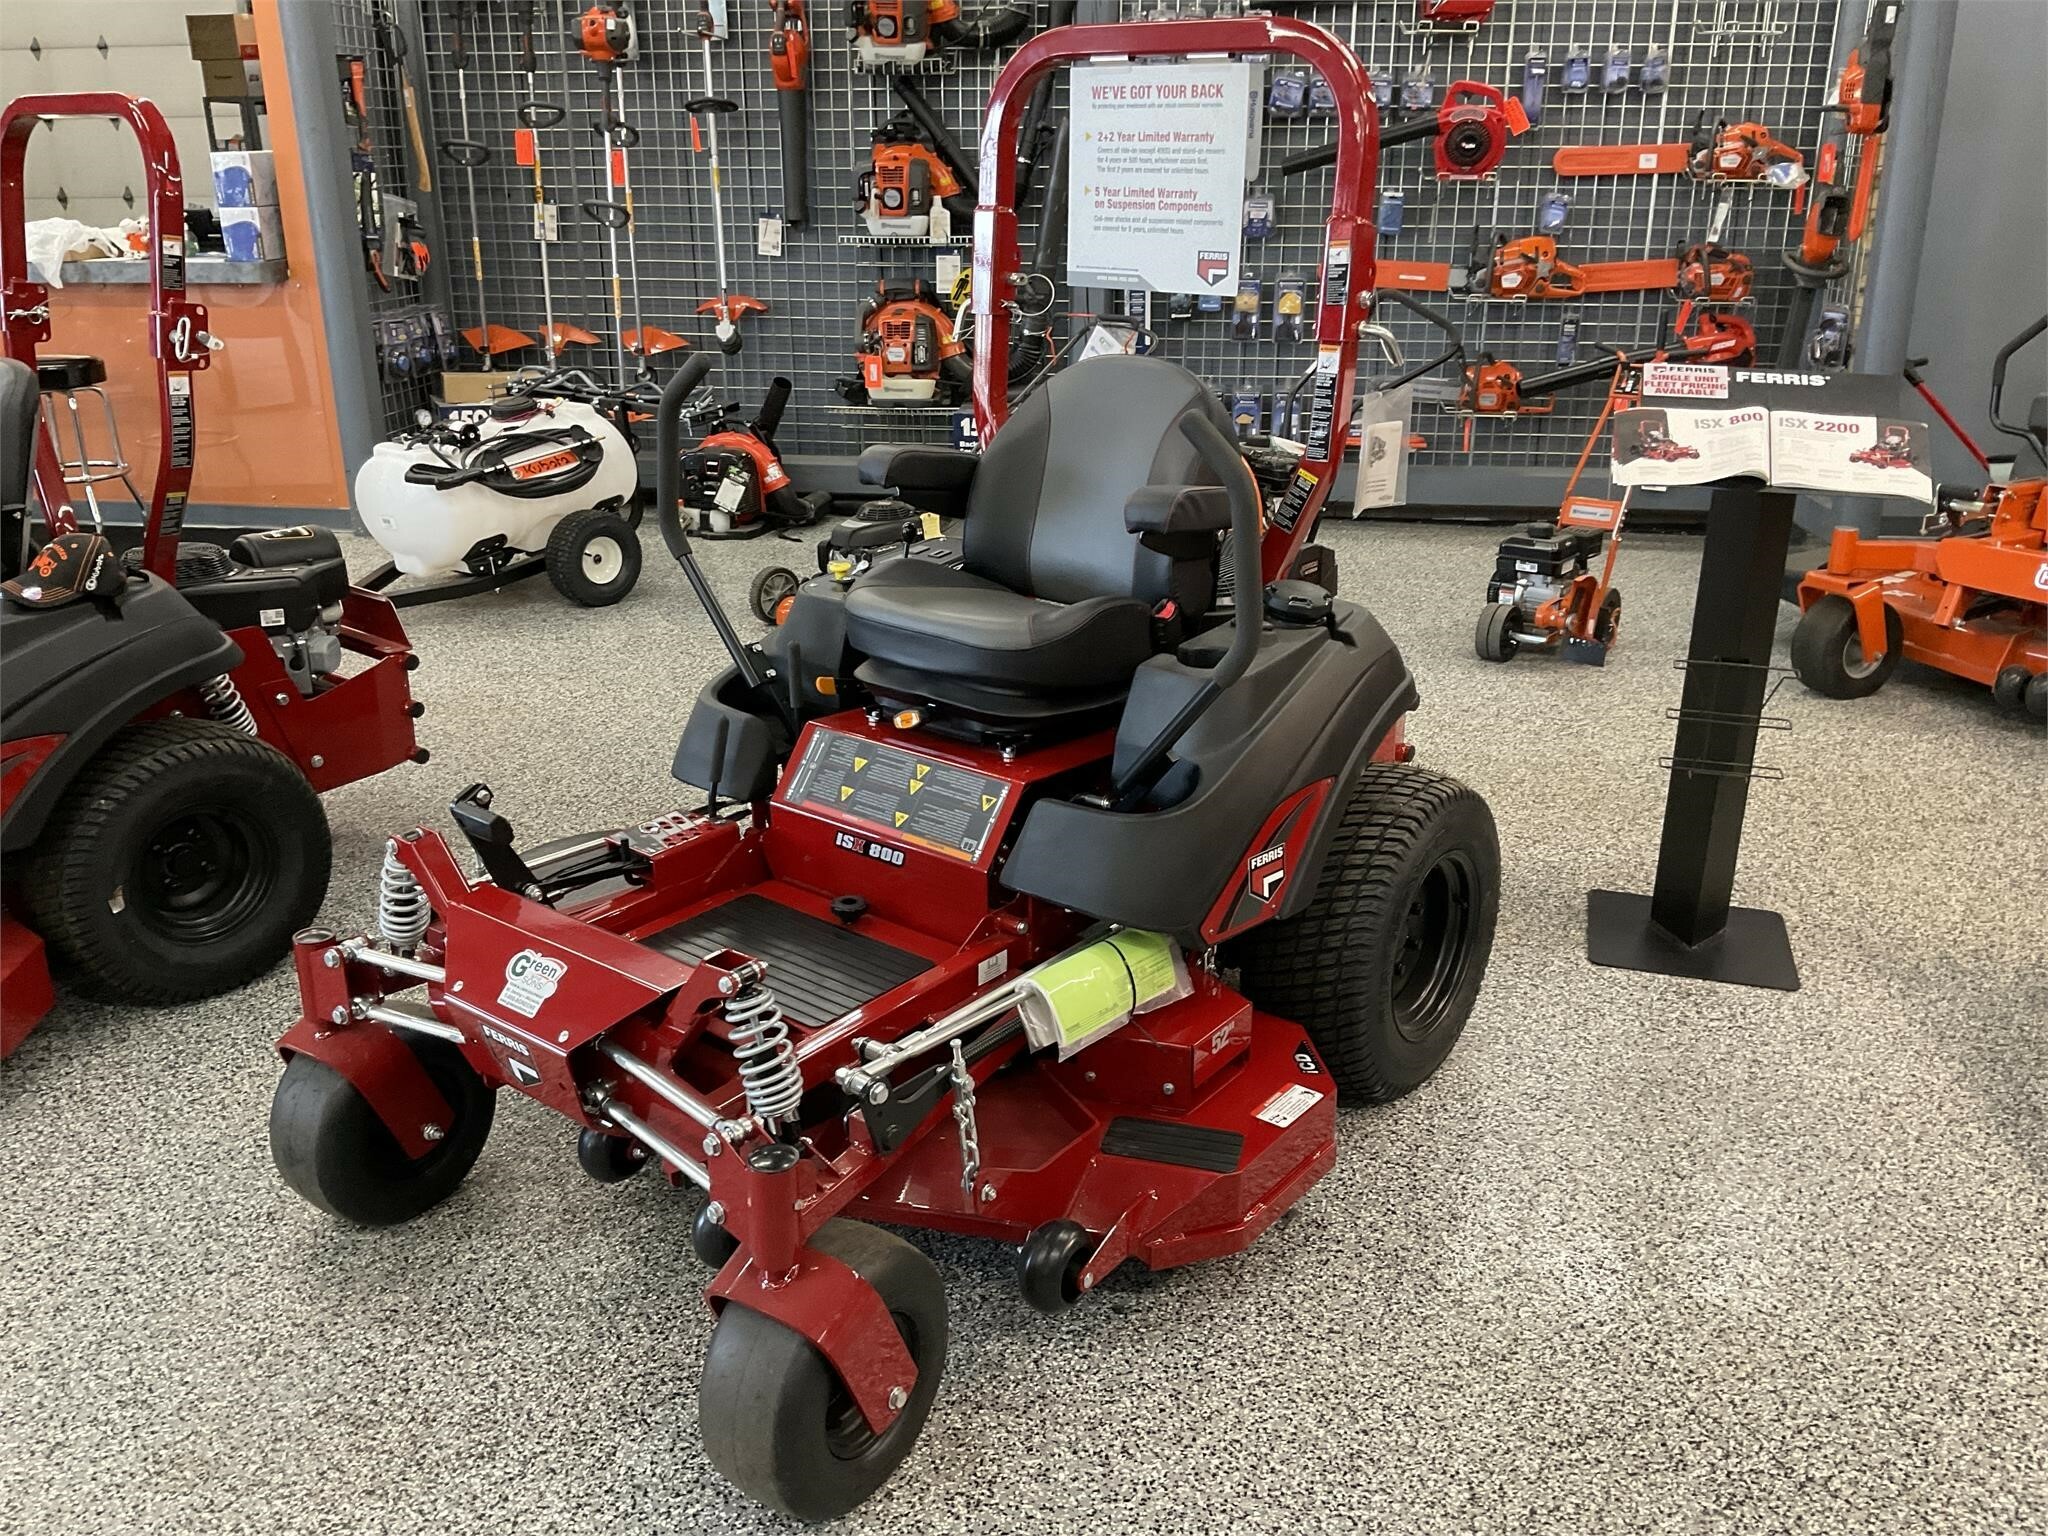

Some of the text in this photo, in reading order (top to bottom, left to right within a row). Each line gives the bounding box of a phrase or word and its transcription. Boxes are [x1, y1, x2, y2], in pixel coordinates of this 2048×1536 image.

[1091, 83, 1224, 100] WE'VE GOT YOUR BACK
[1097, 131, 1215, 145] 2+2 Year Limited Warranty
[1095, 186, 1198, 201] 5 Year Limited Warranty
[1094, 199, 1213, 214] on Suspension Components
[1199, 252, 1228, 260] FERRIS
[1651, 374, 1691, 382] SINGLE
[1669, 366, 1716, 374] FERRIS
[1681, 382, 1727, 390] PRICING
[1735, 371, 1827, 387] FERRIS
[1654, 387, 1717, 396] AVAILABLE
[1694, 412, 1764, 430] ISX 800
[1778, 417, 1860, 434] ISX 2200
[523, 455, 570, 475] Kubota
[835, 832, 904, 866] ISX 800
[1251, 846, 1284, 870] FERRIS
[511, 954, 558, 979] Green
[482, 1025, 530, 1057] FERRIS
